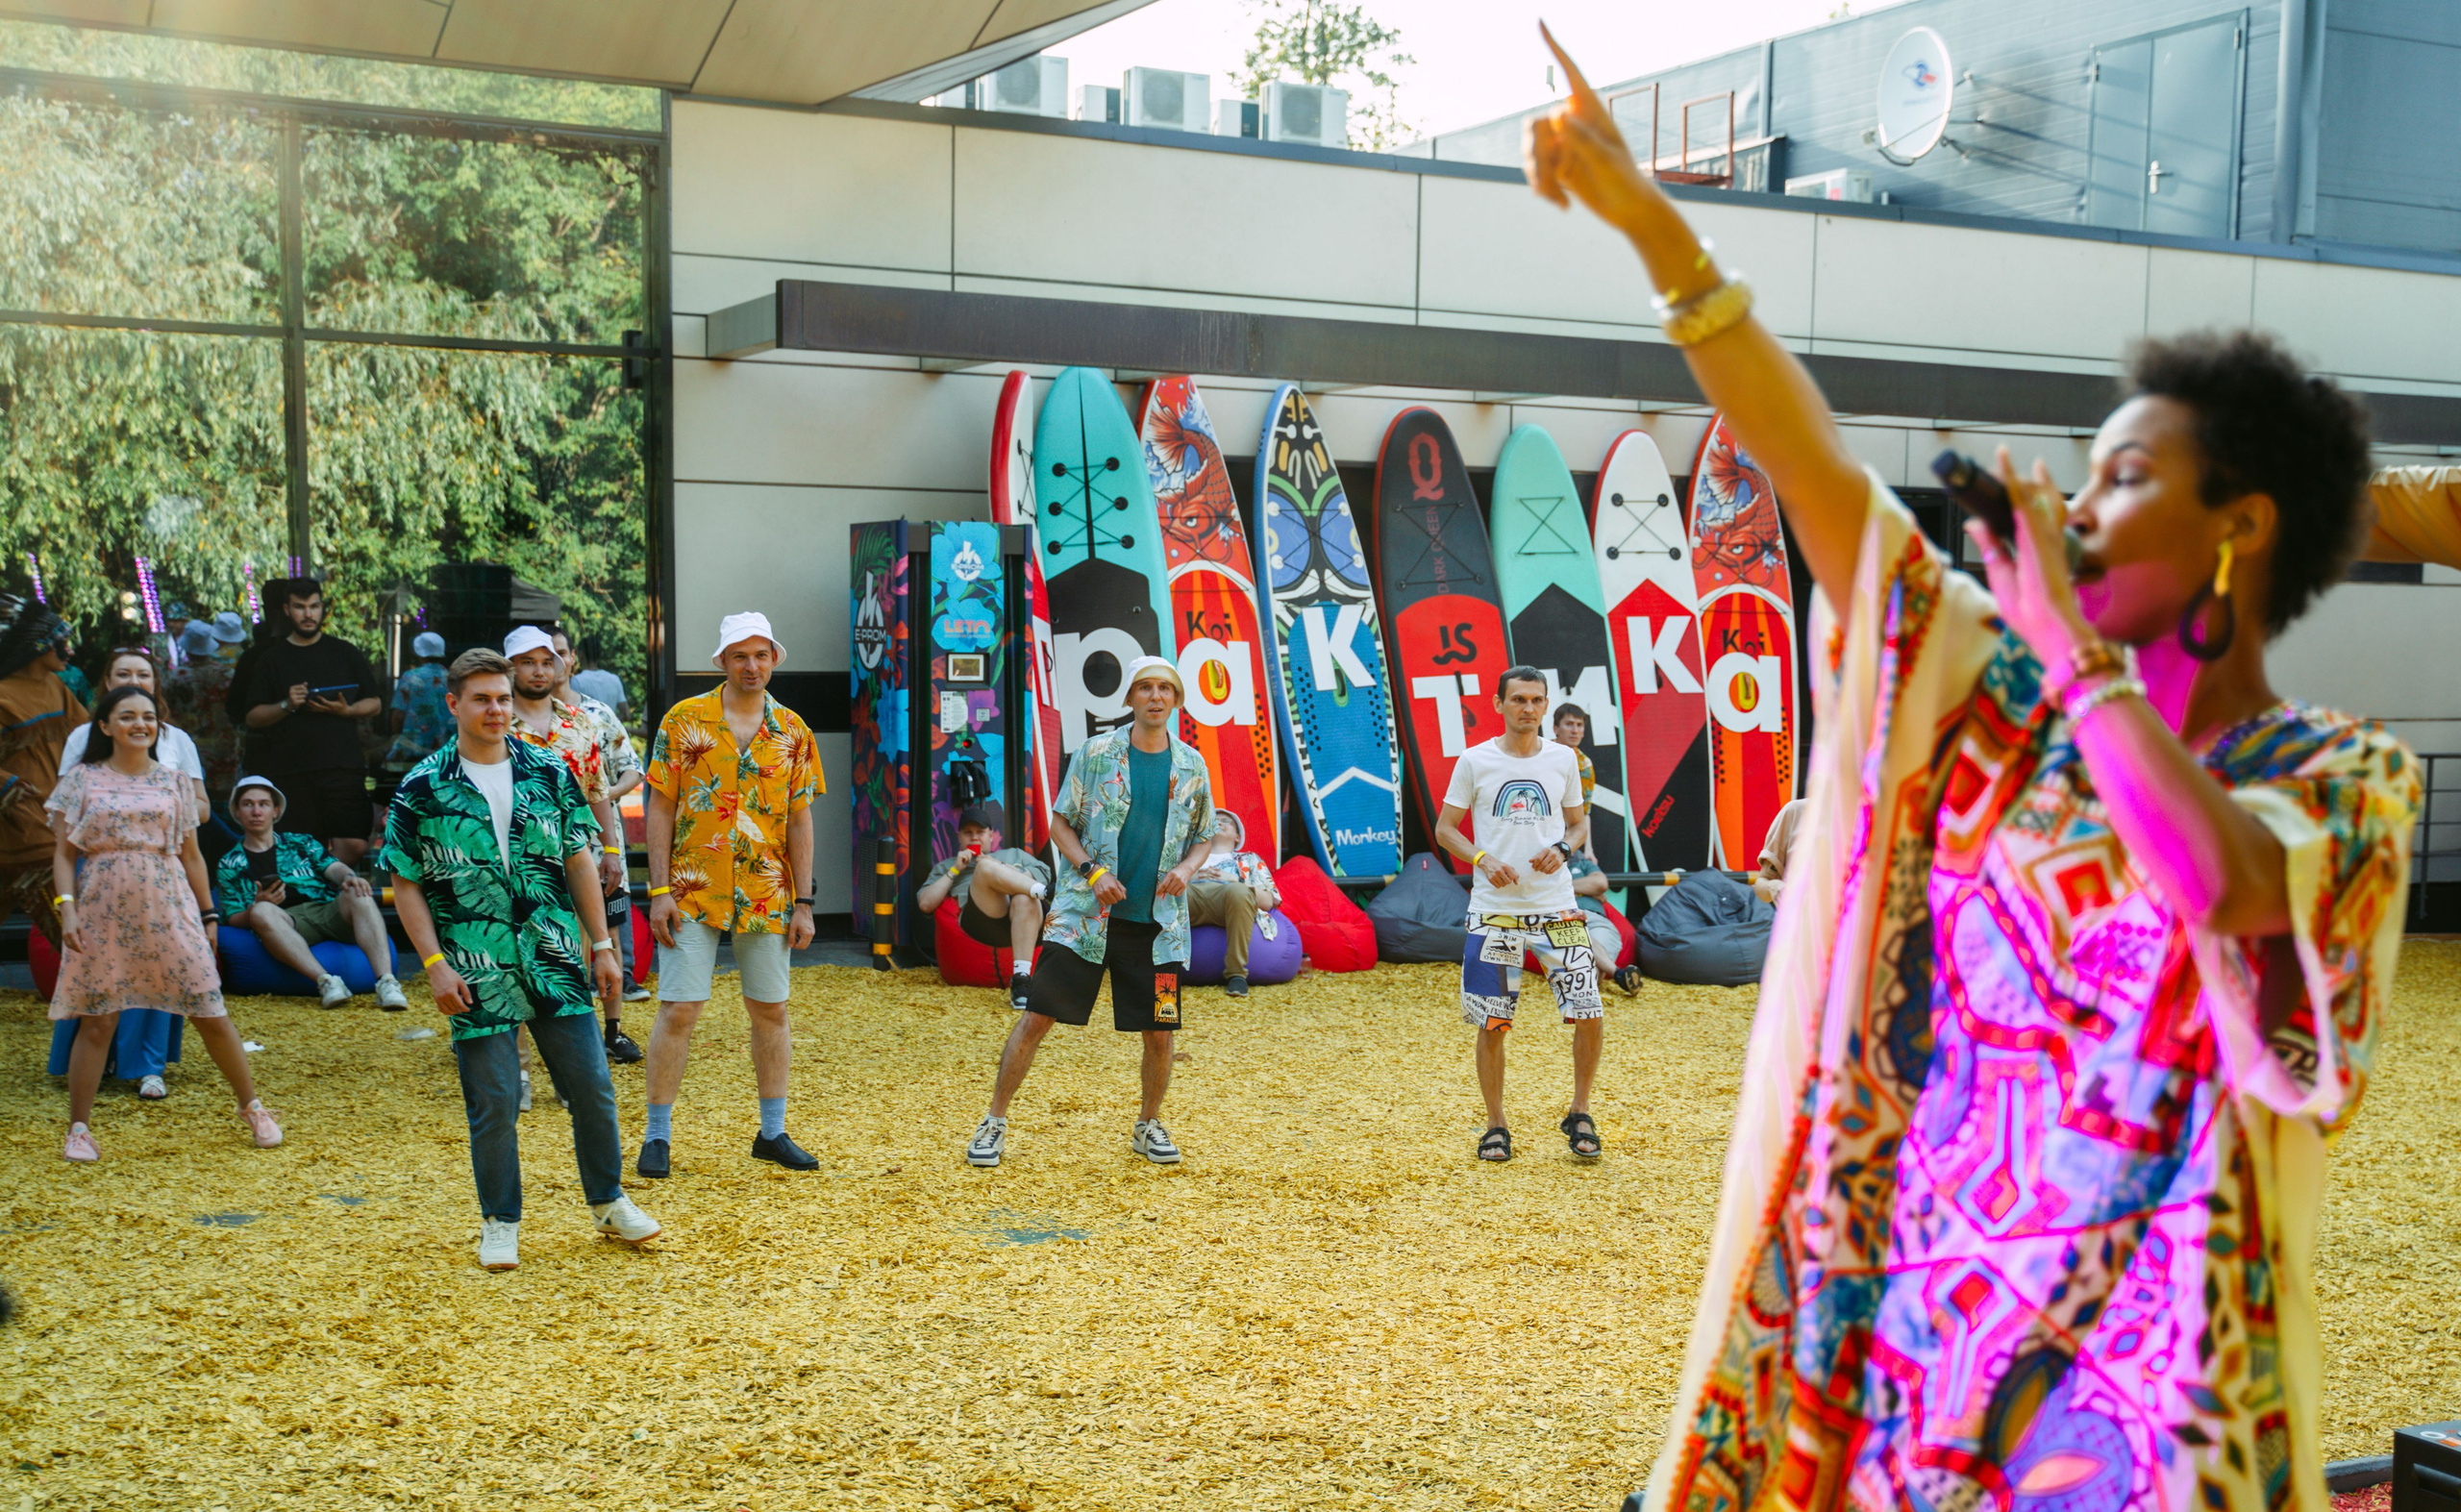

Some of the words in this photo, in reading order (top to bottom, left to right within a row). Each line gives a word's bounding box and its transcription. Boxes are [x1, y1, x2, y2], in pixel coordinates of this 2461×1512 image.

[1407, 433, 1445, 501] Q
[1434, 556, 1450, 594] DARK
[1185, 610, 1233, 640] Koi
[855, 629, 886, 640] E-PROM
[1722, 629, 1765, 655] Koi
[1335, 827, 1397, 846] Monkey
[1547, 920, 1585, 930] CAUTION
[1498, 933, 1517, 942] SWIM
[1557, 929, 1581, 937] KEEP
[1557, 935, 1587, 945] CLEAR
